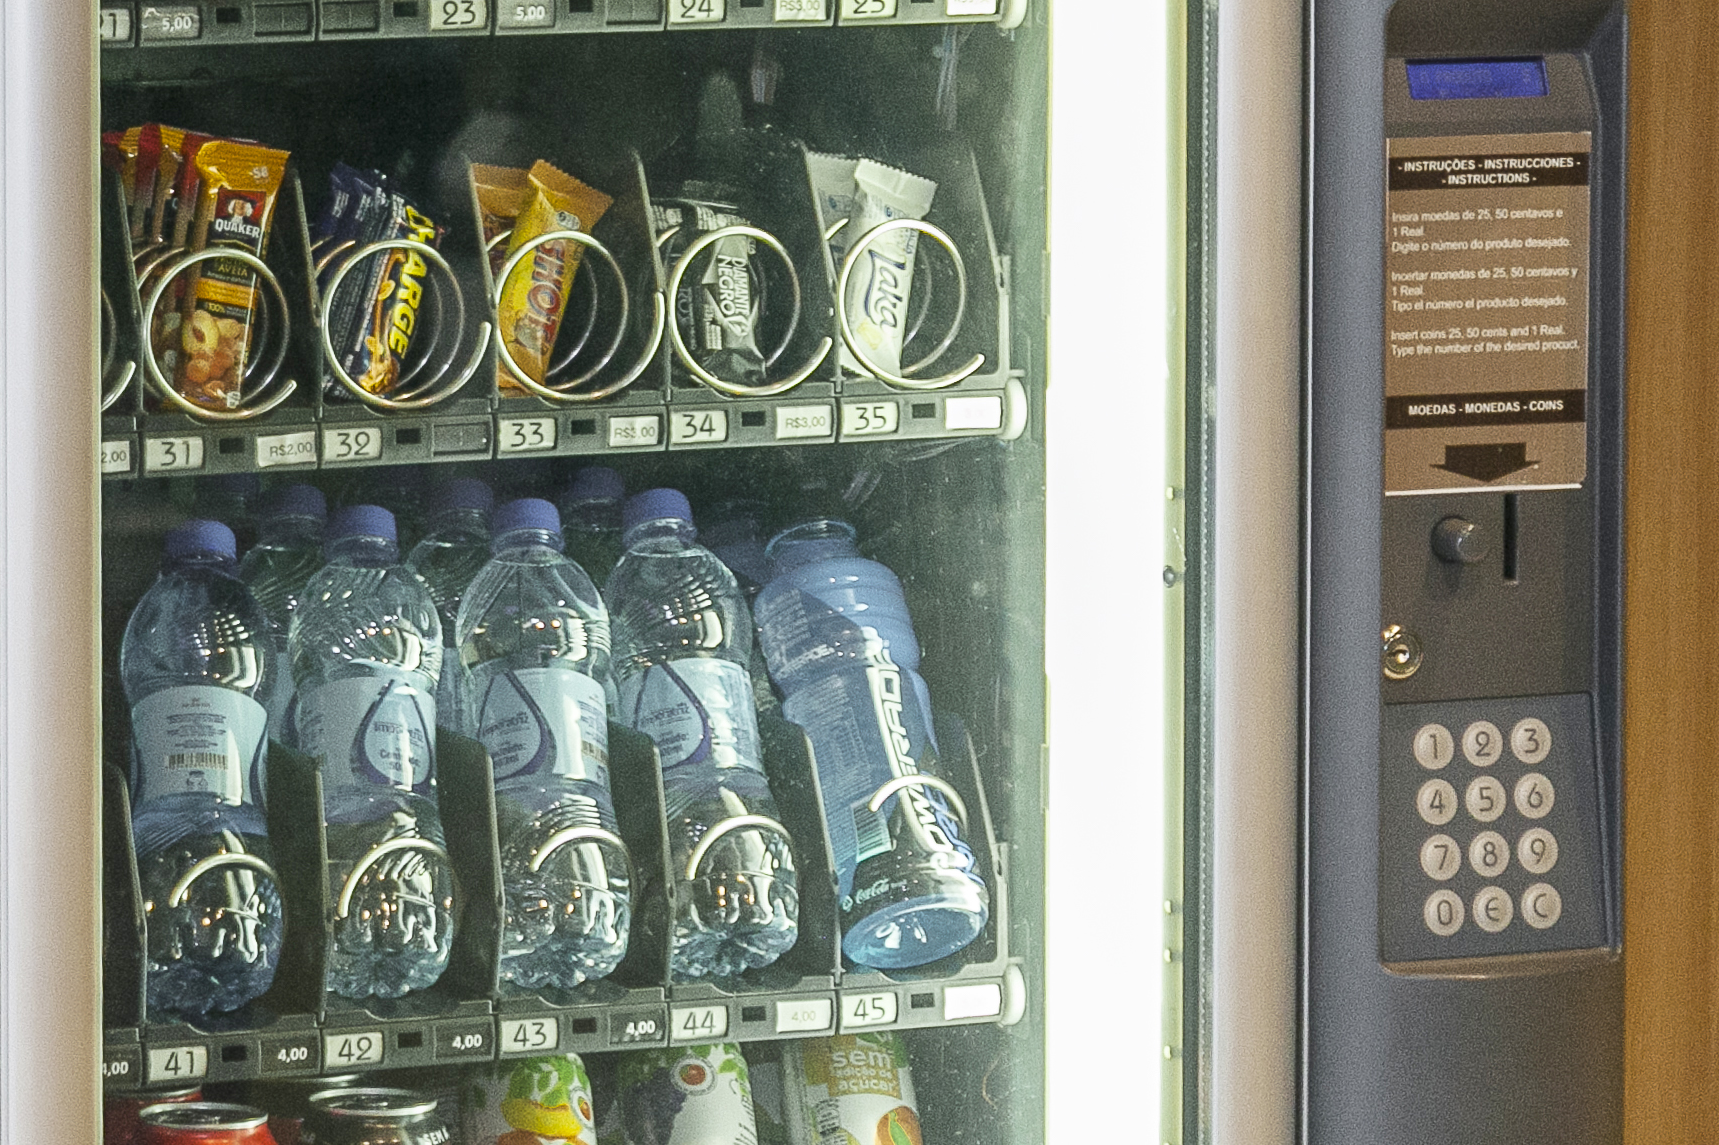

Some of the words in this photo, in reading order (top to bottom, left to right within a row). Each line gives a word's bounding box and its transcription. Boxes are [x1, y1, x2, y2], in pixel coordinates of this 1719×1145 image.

[442, 0, 477, 25] 23
[515, 5, 546, 22] 5,00
[161, 15, 192, 32] 5,00
[1404, 158, 1476, 173] INSTRUÇÕES
[1484, 157, 1574, 170] INSTRUCCIONES
[1448, 172, 1530, 185] INSTRUCTIONS
[1421, 210, 1460, 222] moedas
[1462, 209, 1476, 220] de
[1495, 208, 1509, 219] 50
[1510, 207, 1555, 220] centavos
[1556, 208, 1564, 218] e
[215, 218, 261, 238] QUAKER
[1421, 243, 1429, 252] o
[1470, 239, 1484, 251] do
[1485, 238, 1524, 252] produto
[389, 204, 437, 359] CHARGE
[1477, 268, 1491, 279] de
[1510, 266, 1524, 278] 50
[717, 254, 736, 318] NEGRO
[731, 256, 750, 317] DIAMANTE
[1391, 300, 1413, 313] Tipo
[1476, 297, 1520, 311] producto
[1391, 329, 1419, 341] Insert
[1466, 326, 1480, 338] 50
[1510, 324, 1530, 336] and
[1391, 343, 1415, 358] Type
[1416, 344, 1433, 356] the
[1434, 343, 1473, 354] number
[1473, 341, 1485, 353] of
[1485, 341, 1502, 353] the
[1504, 340, 1541, 352] desired
[1408, 404, 1456, 416] MOEDAS
[1464, 401, 1521, 415] MONEDAS
[1529, 399, 1565, 412] COINS
[681, 413, 717, 439] 34
[785, 416, 827, 430] R$3,00
[854, 405, 887, 431] 35
[510, 421, 545, 447] 33
[160, 441, 191, 467] 31
[268, 441, 313, 458] R$2,00
[334, 431, 371, 458] 32
[1428, 733, 1440, 760] 1
[1475, 730, 1492, 757] 2
[1523, 727, 1540, 754] 3
[1429, 789, 1445, 816] 4
[1479, 786, 1495, 813] 5
[1527, 782, 1544, 810] 6
[1433, 844, 1449, 871] 7
[1482, 840, 1498, 868] 8
[1530, 837, 1546, 865] 9
[1436, 899, 1454, 927] 0
[1485, 896, 1500, 923] E
[1532, 892, 1549, 920] C
[790, 1008, 818, 1022] 4,00
[851, 997, 886, 1022] 45
[625, 1020, 657, 1036] 4,00
[682, 1011, 716, 1035] 44
[451, 1033, 483, 1050] 4,00
[513, 1021, 547, 1048] 43
[277, 1046, 309, 1062] 4,00
[338, 1036, 374, 1062] 42
[831, 1049, 892, 1068] sem
[163, 1049, 196, 1076] 41
[838, 1075, 895, 1093] açúcar
